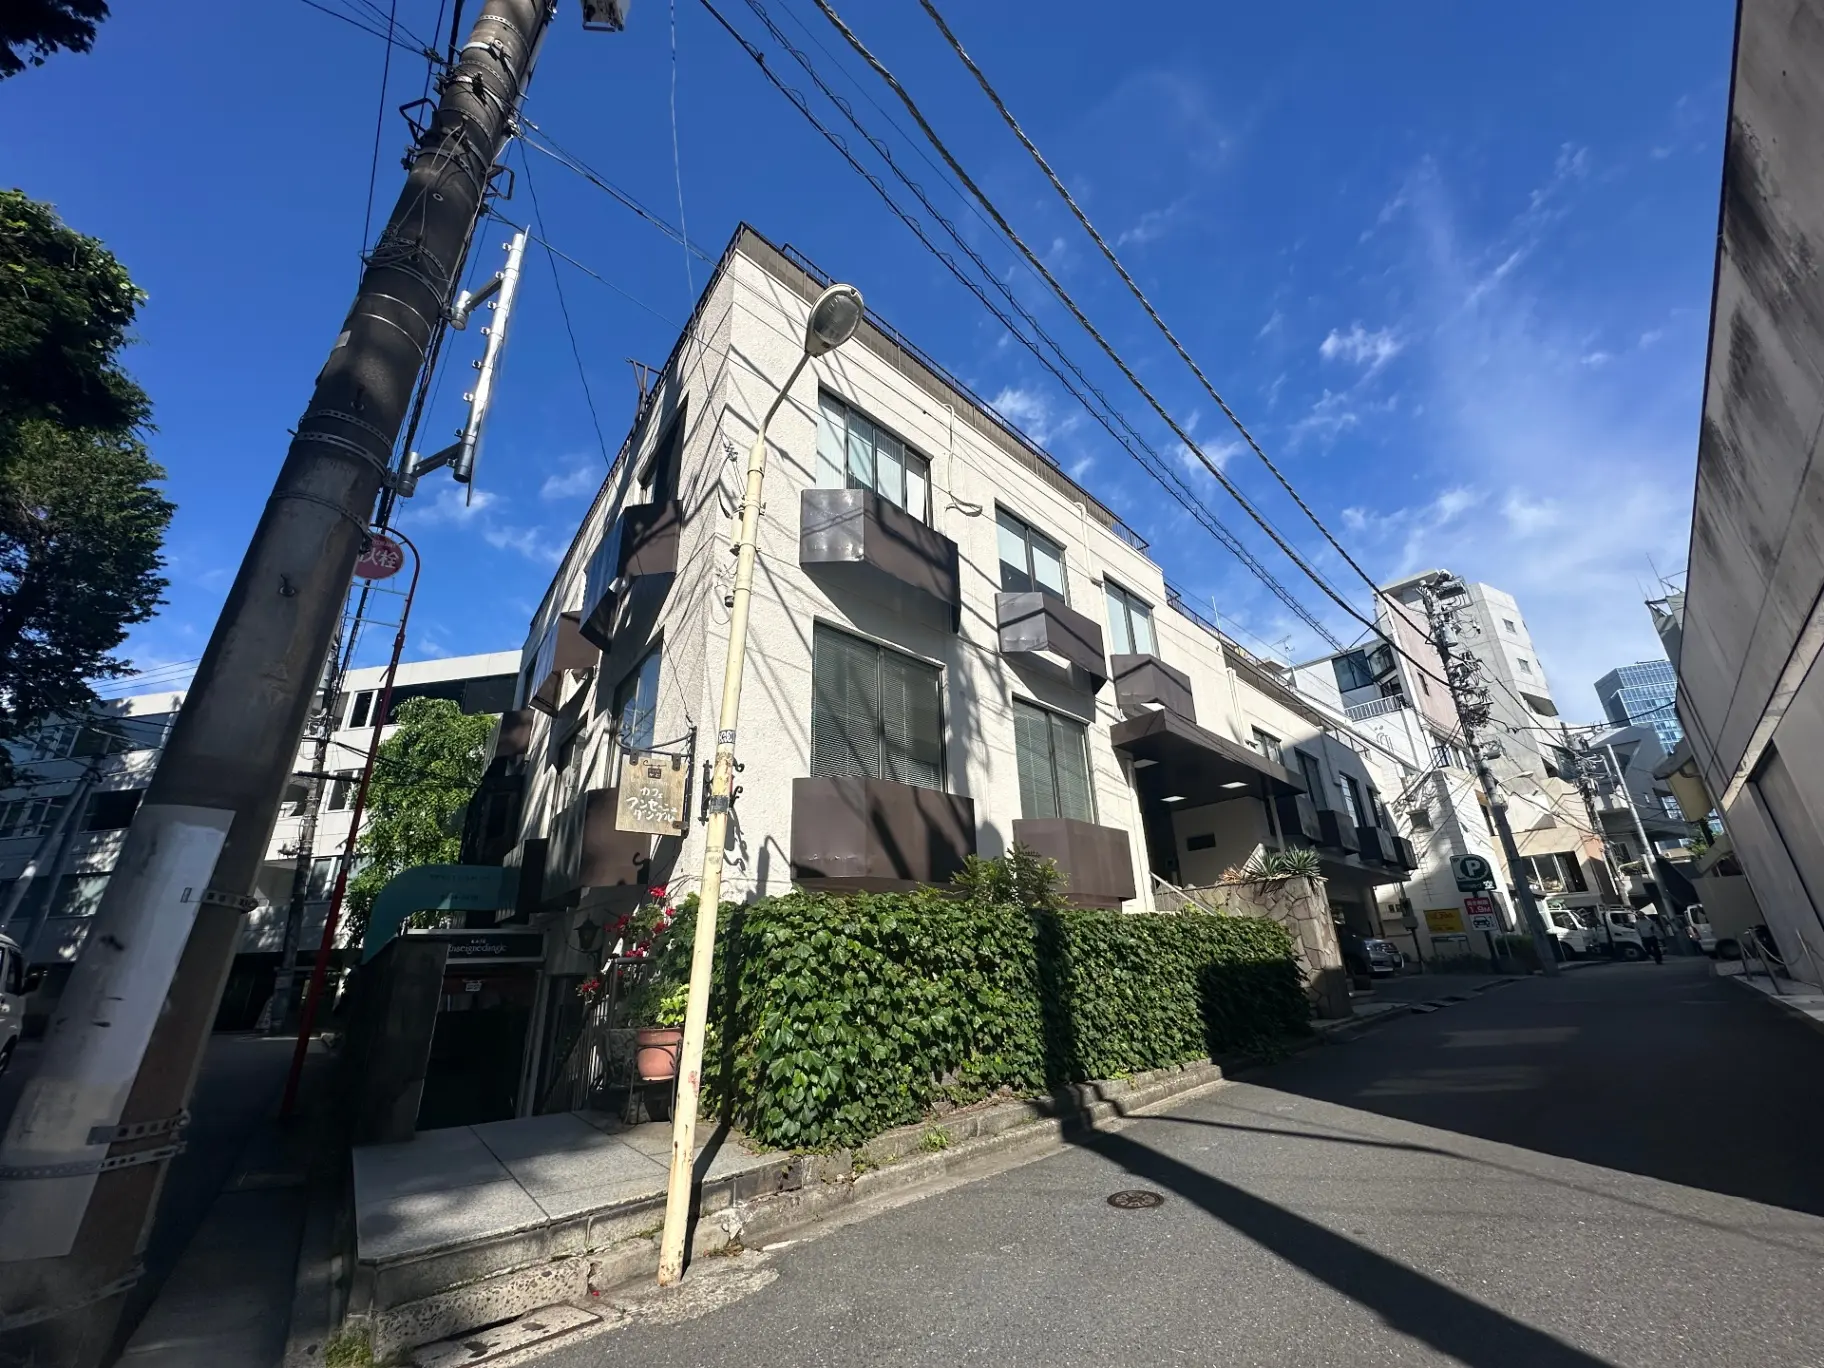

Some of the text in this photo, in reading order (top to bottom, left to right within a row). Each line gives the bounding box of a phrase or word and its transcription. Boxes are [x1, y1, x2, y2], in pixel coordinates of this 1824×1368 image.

[357, 548, 399, 569] 火栓
[640, 786, 663, 799] カフェ
[1465, 859, 1481, 877] P
